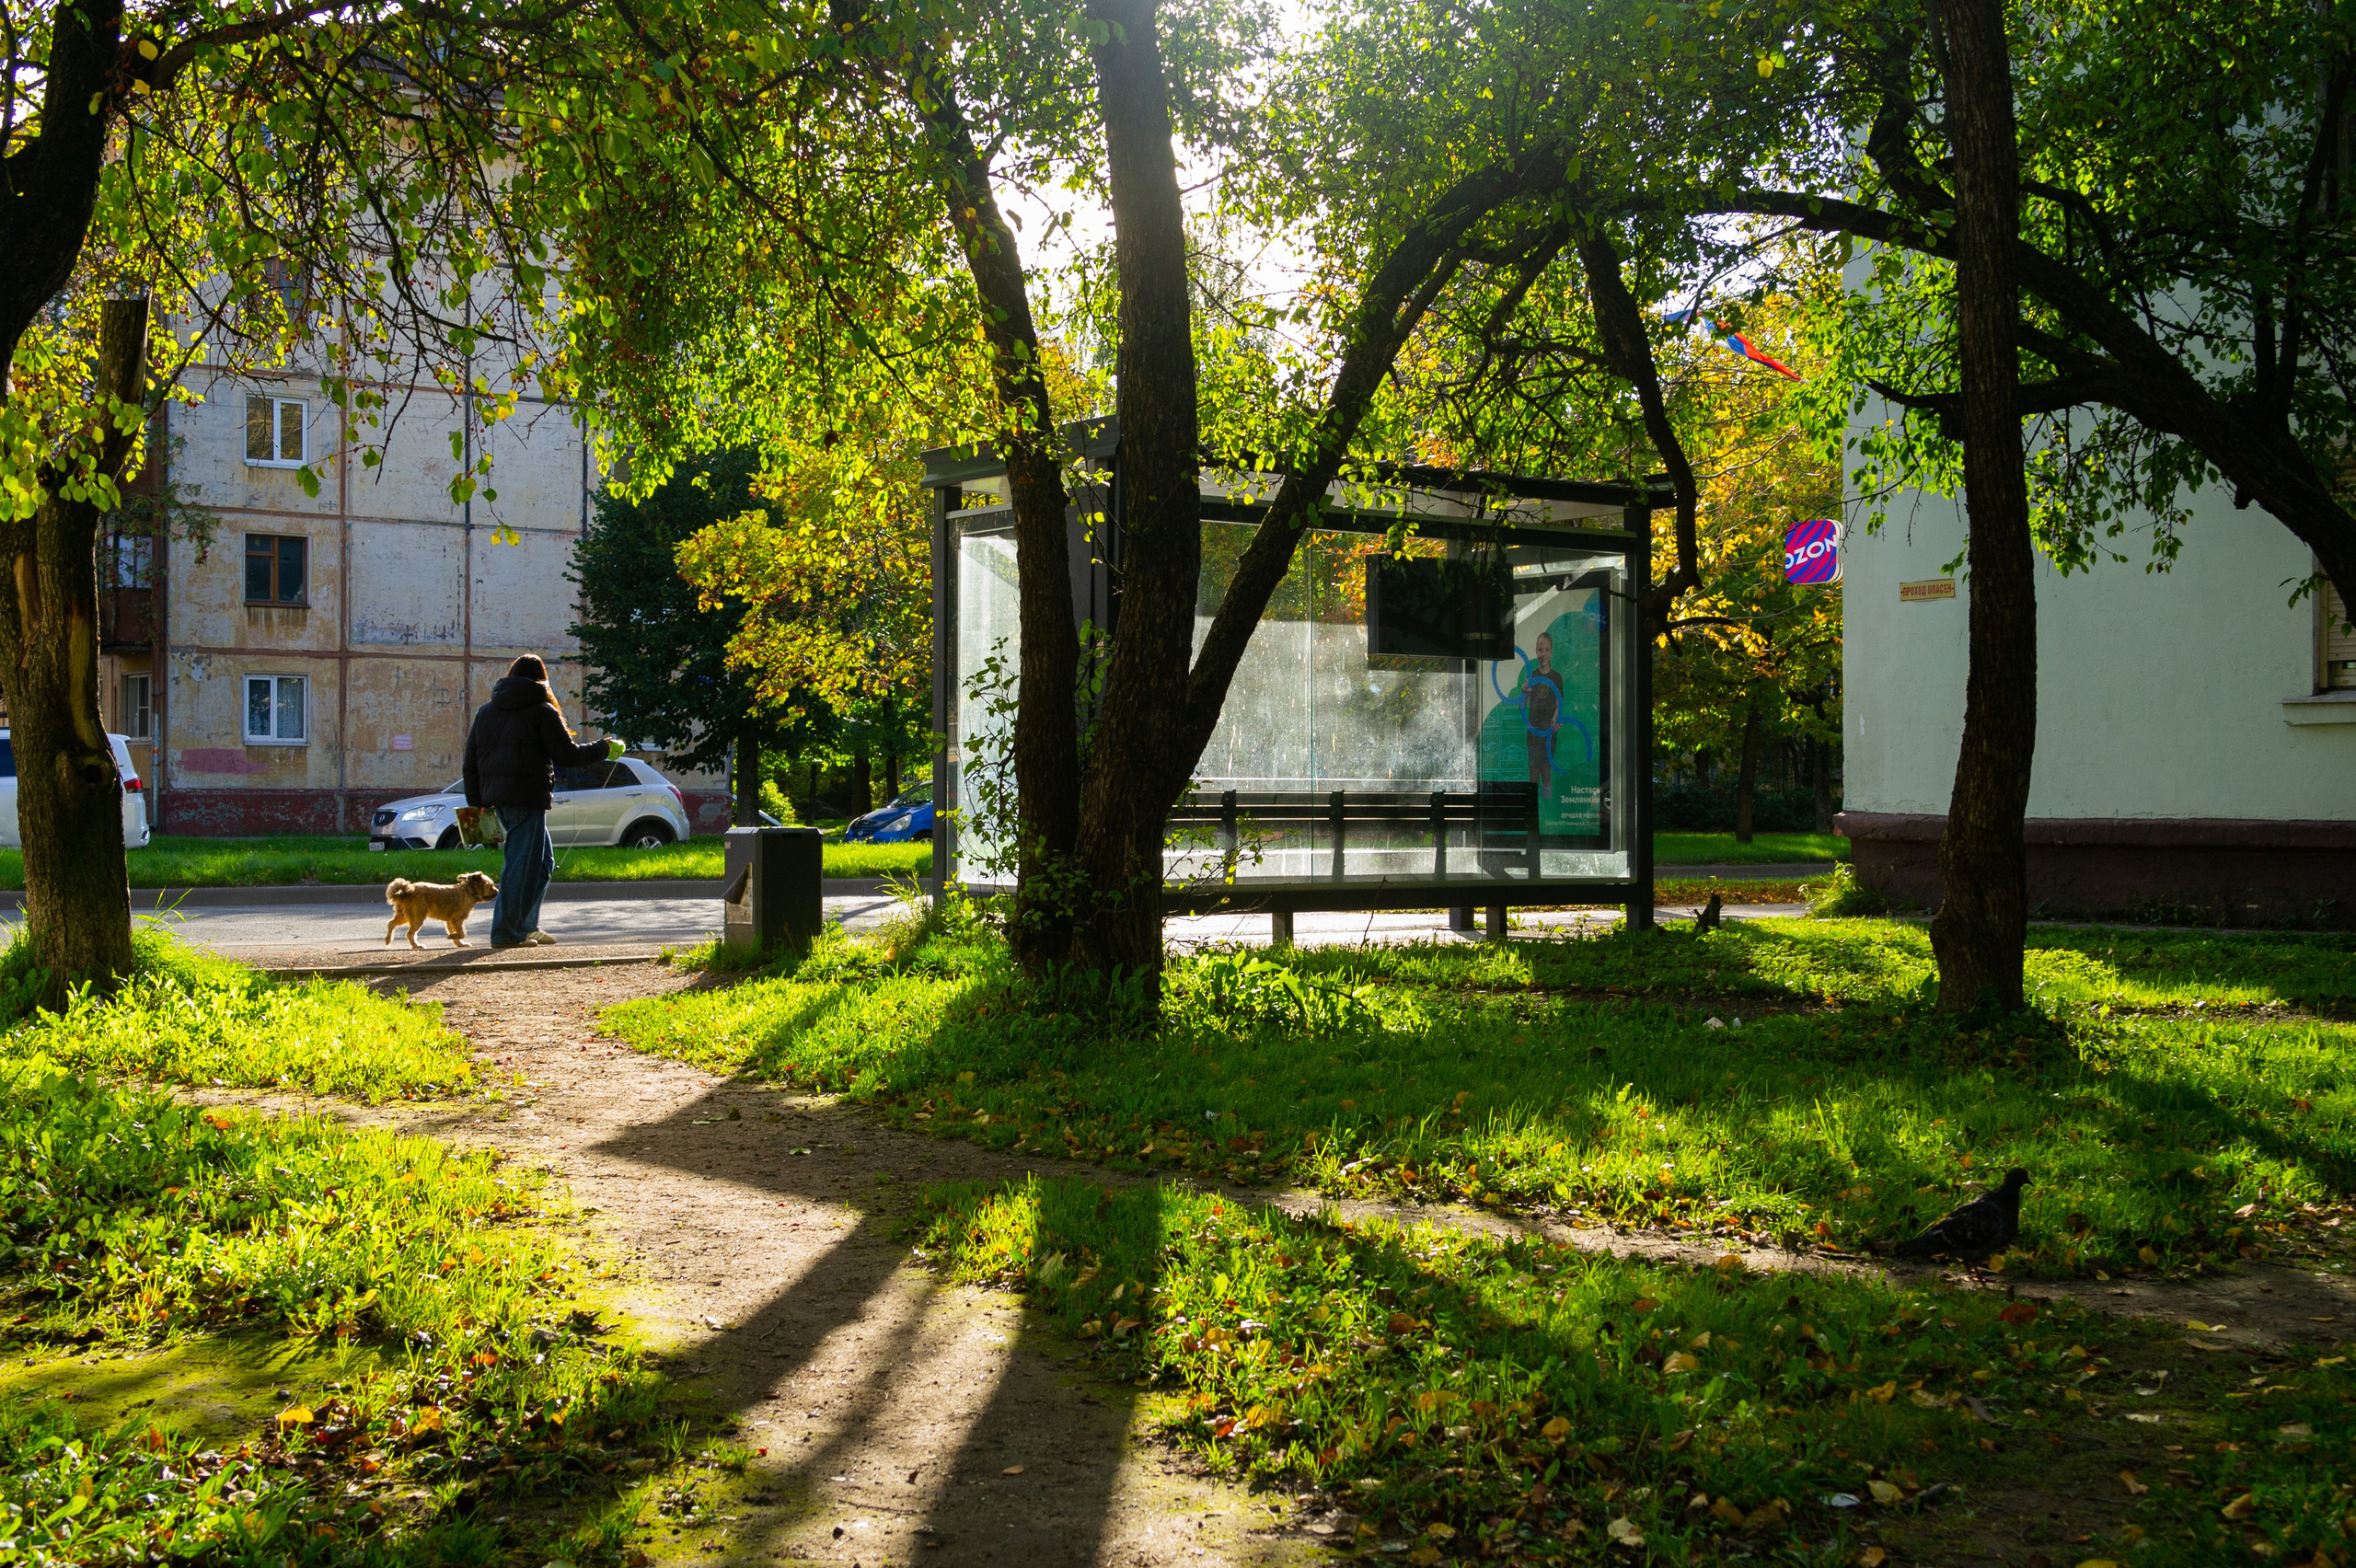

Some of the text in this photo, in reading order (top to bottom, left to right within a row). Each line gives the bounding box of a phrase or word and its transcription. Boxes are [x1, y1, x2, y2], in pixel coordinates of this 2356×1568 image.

[1785, 534, 1837, 569] OZON
[1903, 583, 1952, 596] ПРОХОД ОПАСЕН
